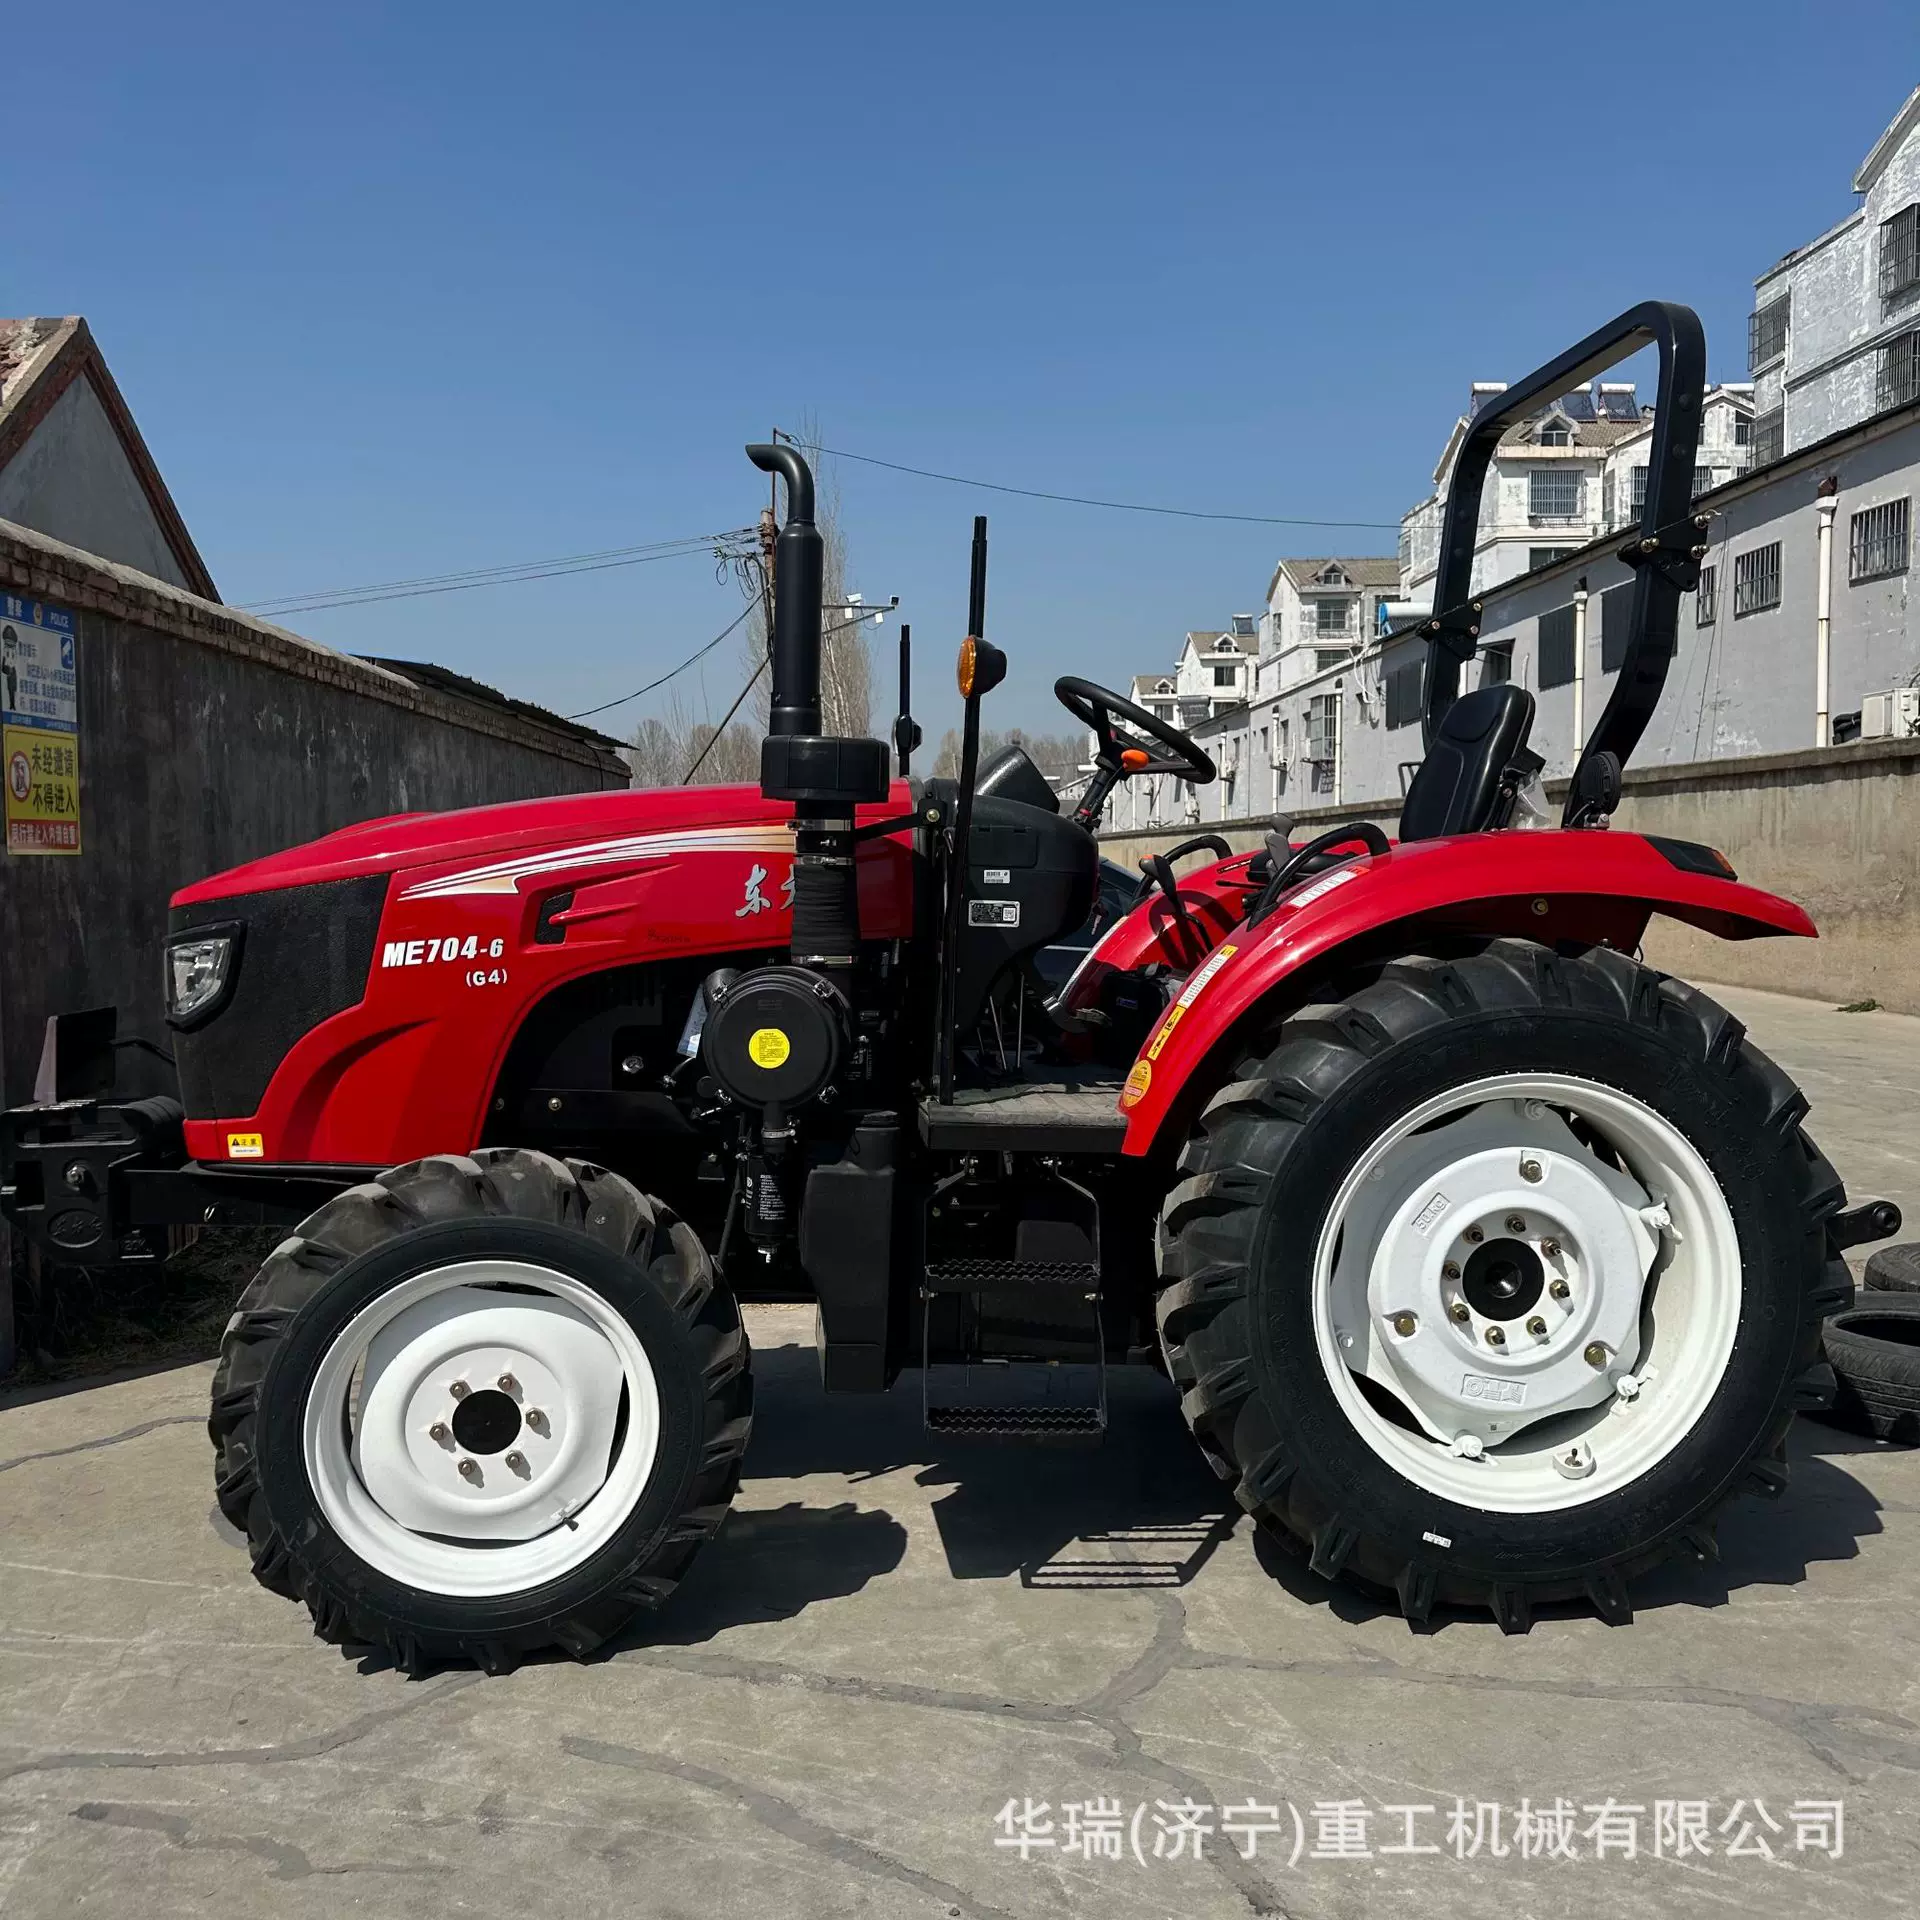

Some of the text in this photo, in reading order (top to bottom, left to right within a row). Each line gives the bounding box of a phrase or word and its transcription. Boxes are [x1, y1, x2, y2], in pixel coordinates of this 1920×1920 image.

[50, 612, 69, 628] POLICE
[32, 783, 75, 813] 不得进入
[382, 937, 504, 968] ME704-6
[466, 968, 508, 987] (G4)
